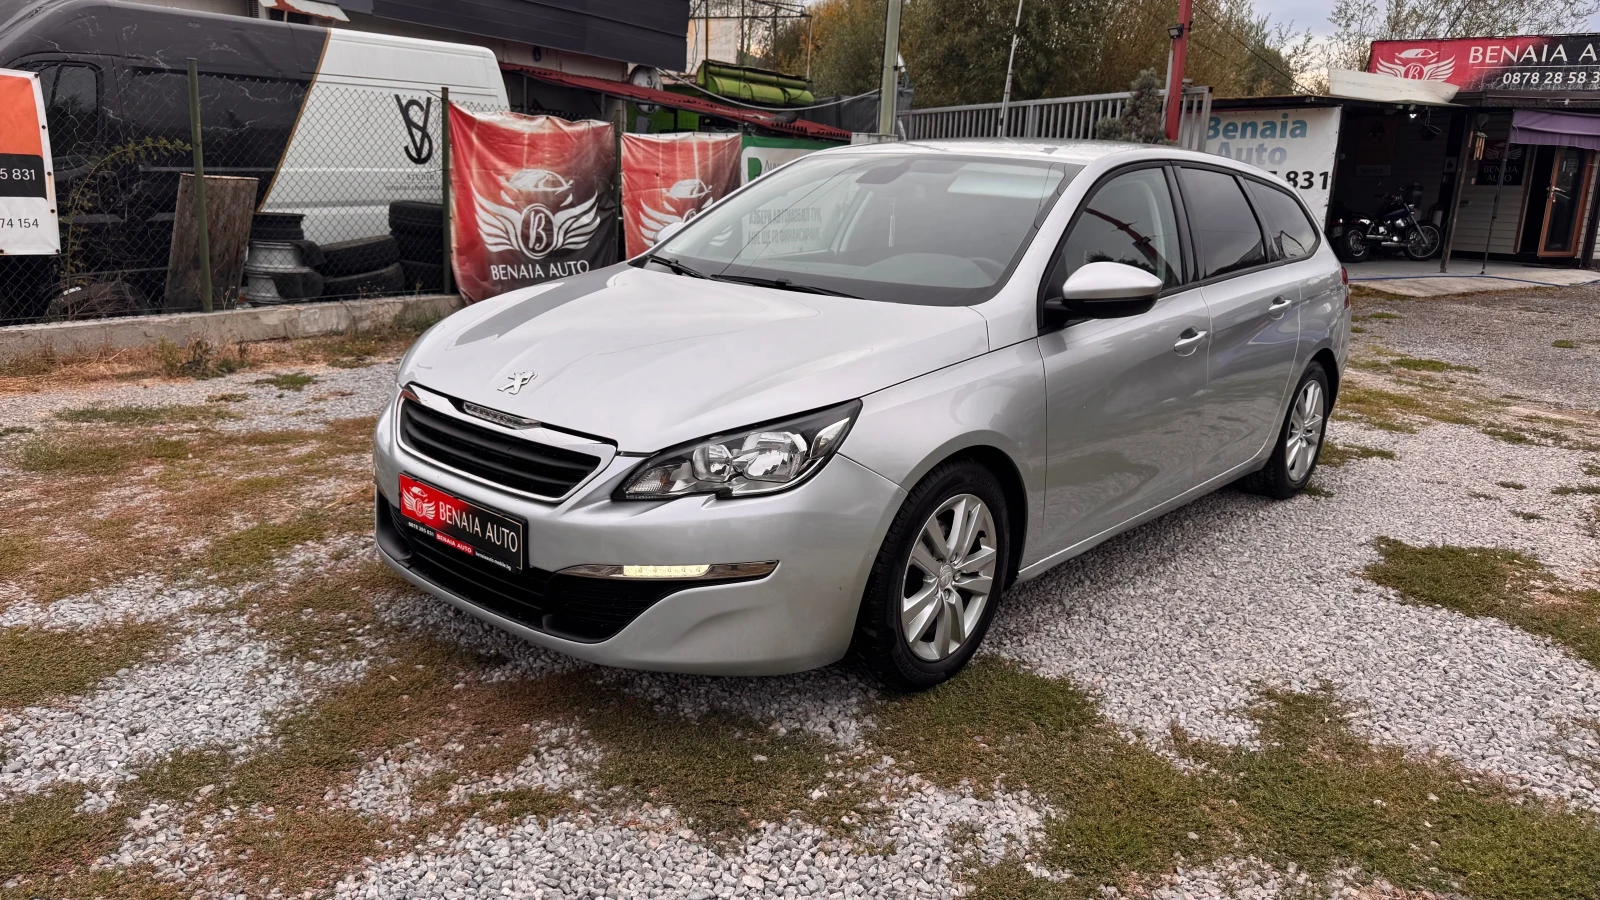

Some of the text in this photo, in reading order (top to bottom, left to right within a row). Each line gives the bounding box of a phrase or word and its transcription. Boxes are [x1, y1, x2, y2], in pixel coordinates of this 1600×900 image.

[1469, 43, 1568, 64] BENAIA
[1502, 71, 1540, 84] 0878
[1544, 71, 1563, 84] 28
[1567, 71, 1587, 84] 58
[1206, 112, 1308, 140] Benaia
[1216, 141, 1288, 166] Auto
[12, 168, 36, 180] 831
[1483, 165, 1518, 173] BENIA
[1486, 174, 1513, 182] AUO
[1285, 170, 1329, 190] 831
[18, 218, 39, 229] 154
[490, 260, 590, 281] BENAIA AUTO
[439, 501, 518, 553] BENAIA AUTO
[436, 533, 472, 554] BENAIA AUTO
